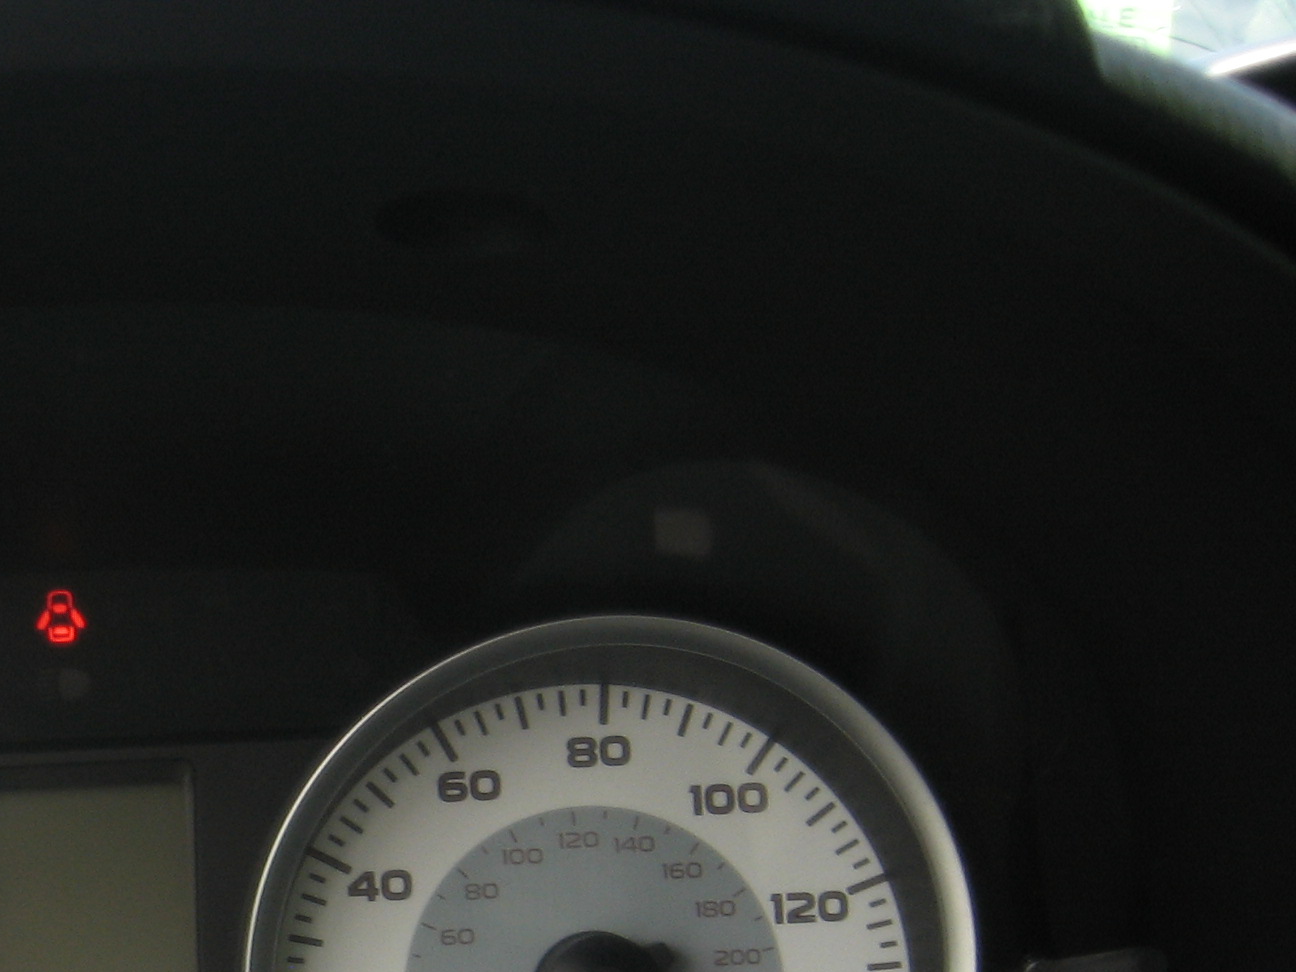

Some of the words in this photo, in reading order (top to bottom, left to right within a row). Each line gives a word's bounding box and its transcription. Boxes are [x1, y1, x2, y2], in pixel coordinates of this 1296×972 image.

[567, 735, 631, 768] 80
[437, 769, 501, 802] 60
[688, 782, 768, 816] 100
[559, 831, 600, 849] 120
[614, 836, 656, 853] 140
[503, 848, 544, 865] 100
[662, 862, 703, 880] 160
[347, 869, 412, 901] 40
[465, 883, 499, 900] 80
[770, 890, 849, 925] 120
[440, 928, 475, 946] 60
[713, 949, 761, 966] 200
